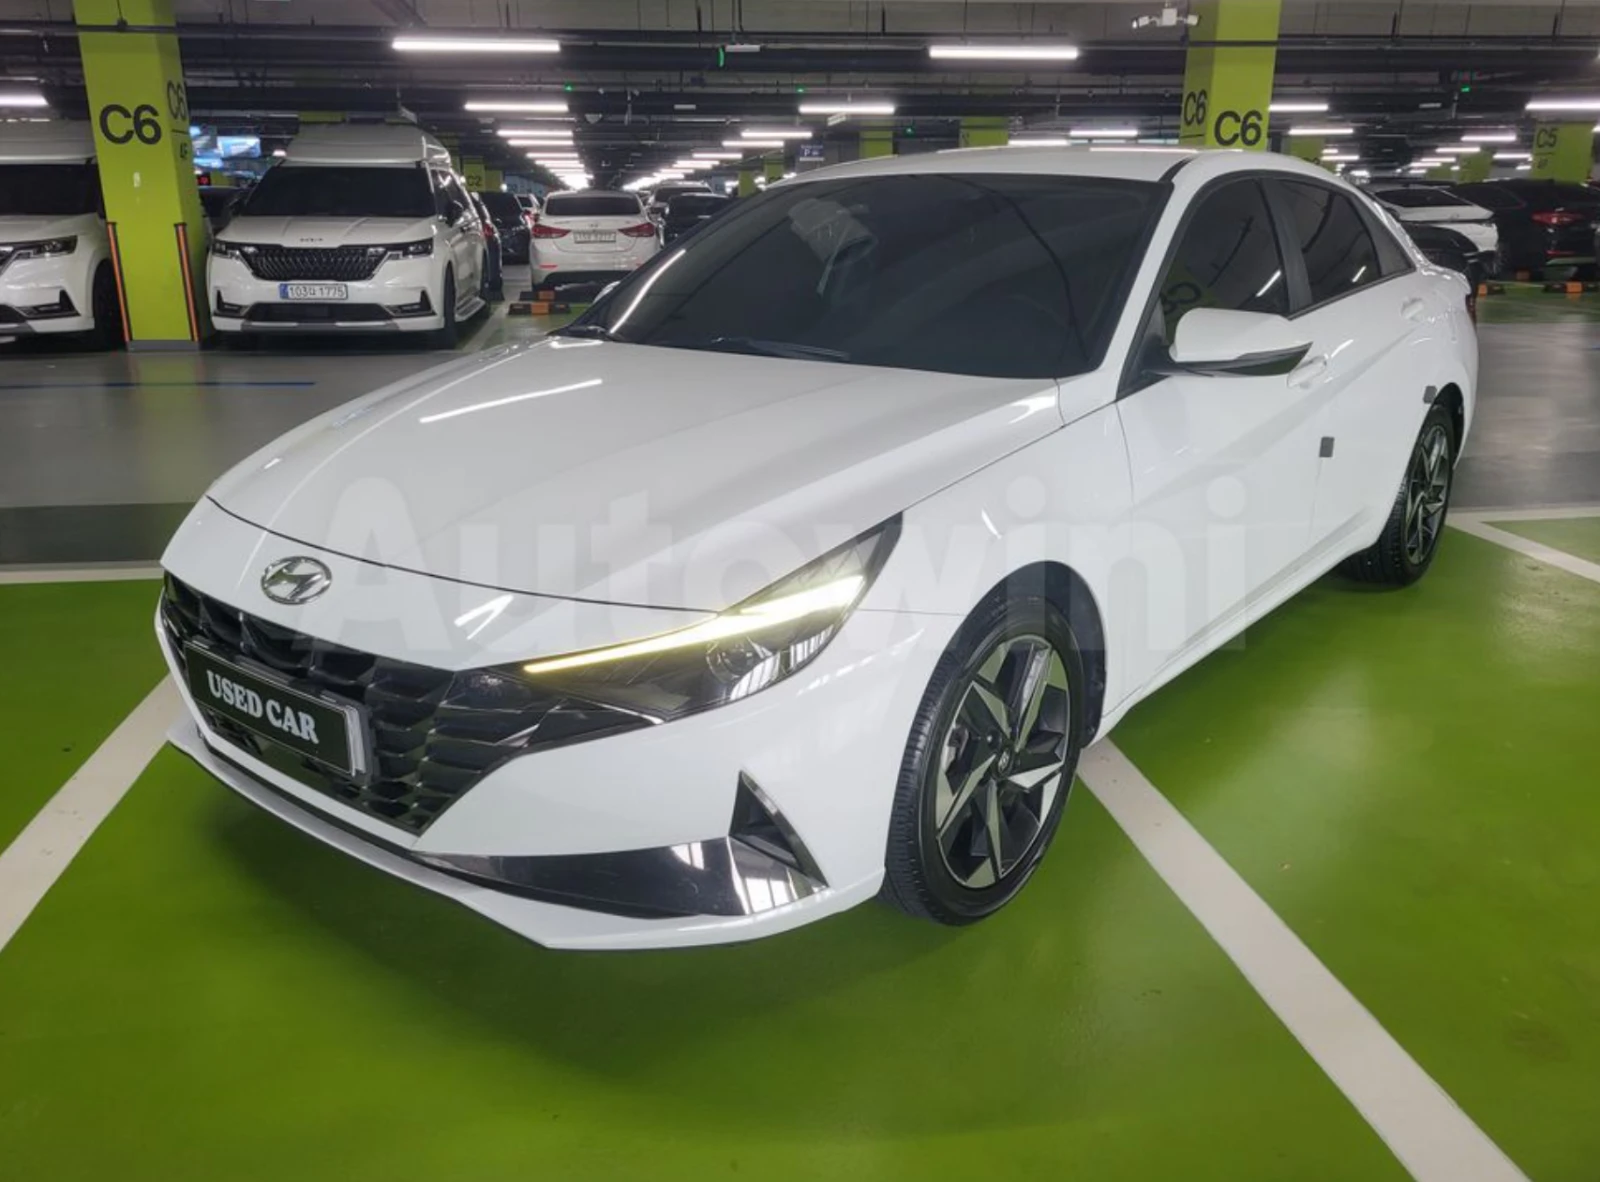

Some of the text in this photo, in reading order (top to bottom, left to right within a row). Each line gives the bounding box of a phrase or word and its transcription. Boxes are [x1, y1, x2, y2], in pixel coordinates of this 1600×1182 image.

[166, 80, 188, 121] C6
[1184, 89, 1207, 126] C6
[99, 104, 162, 145] C6
[1214, 109, 1263, 146] C6
[1537, 127, 1557, 148] C5
[206, 669, 319, 744] USED CAR
